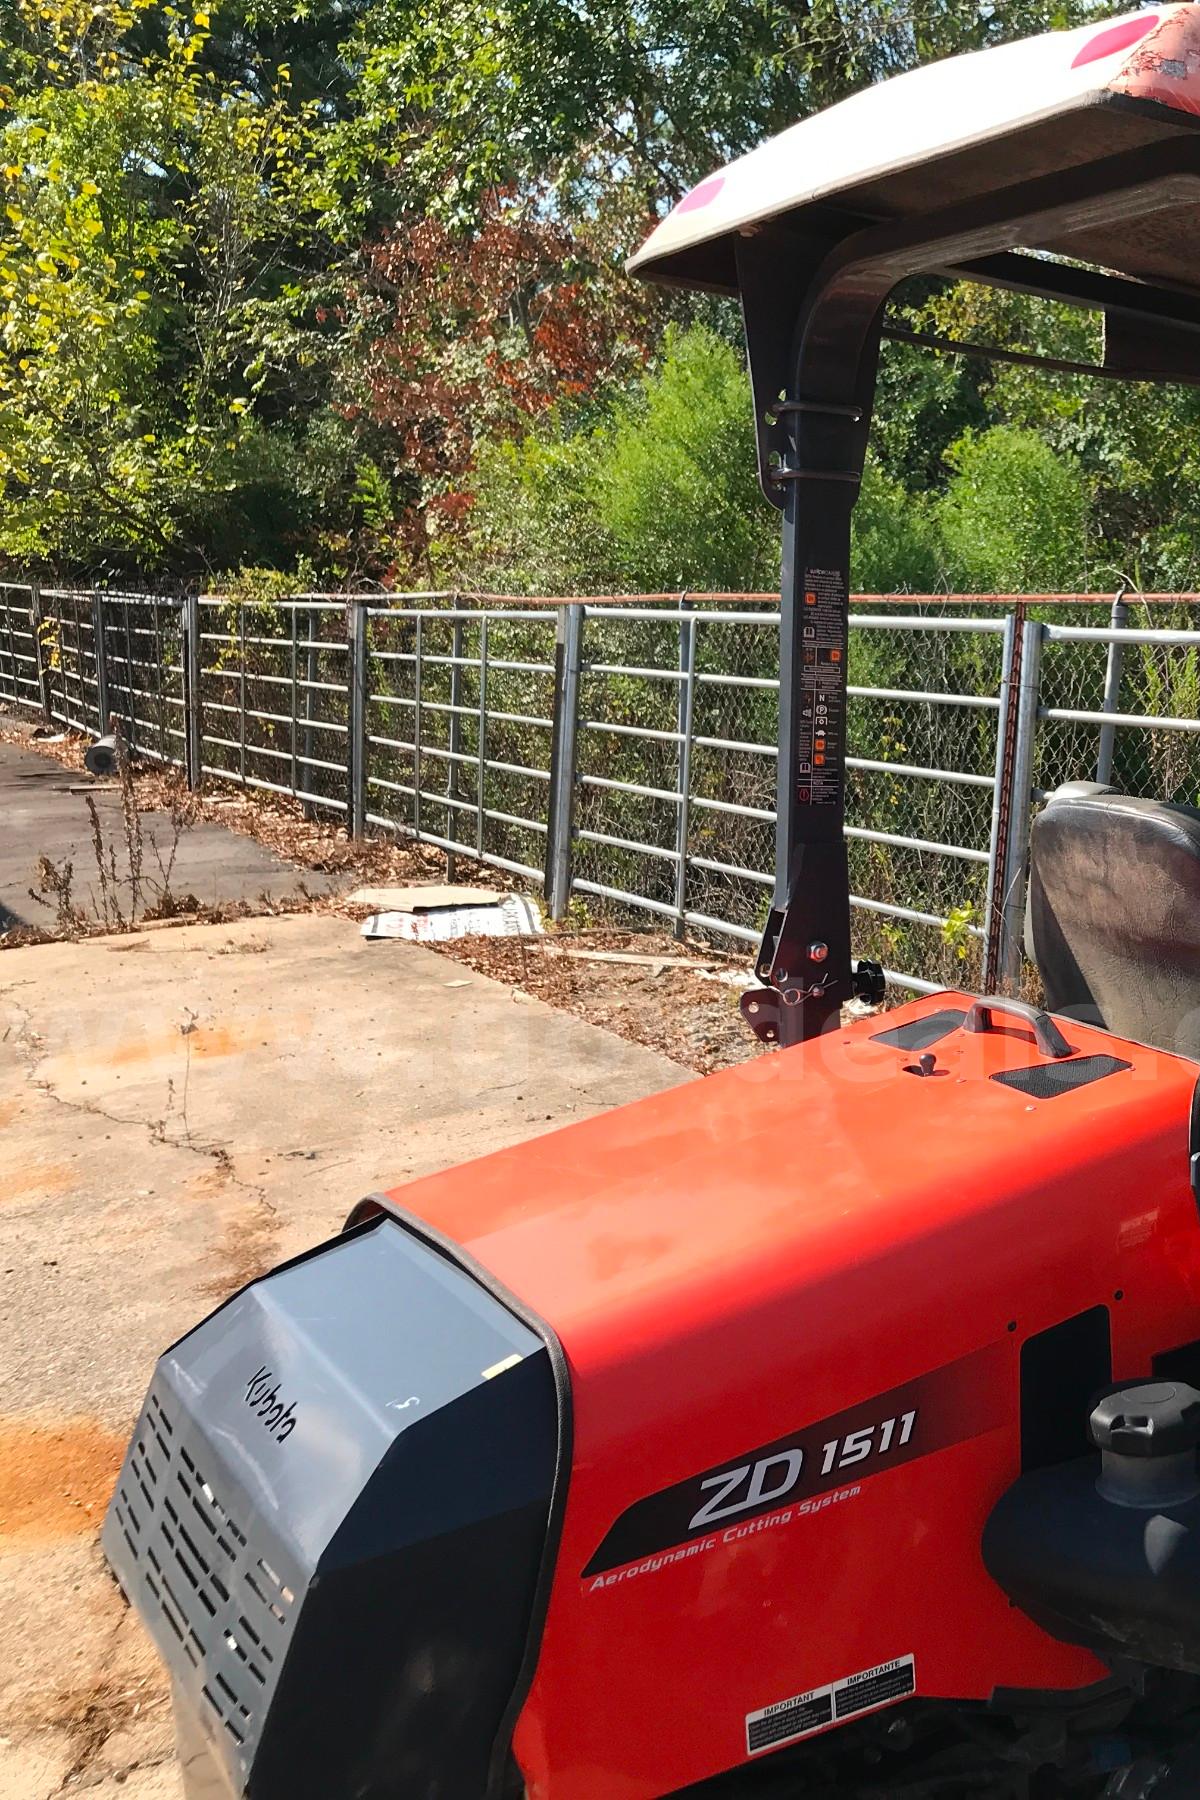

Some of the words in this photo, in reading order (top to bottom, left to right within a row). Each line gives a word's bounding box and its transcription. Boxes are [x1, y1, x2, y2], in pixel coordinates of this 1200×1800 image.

[244, 1366, 298, 1444] Kubota
[688, 1448, 805, 1531] ZD
[820, 1409, 917, 1476] 1511
[589, 1537, 717, 1593] Aerodynamic
[722, 1511, 792, 1544] Cutting
[797, 1485, 862, 1520] System
[763, 1692, 815, 1717] IMPORTANT
[846, 1659, 901, 1686] IMPORTANTE
